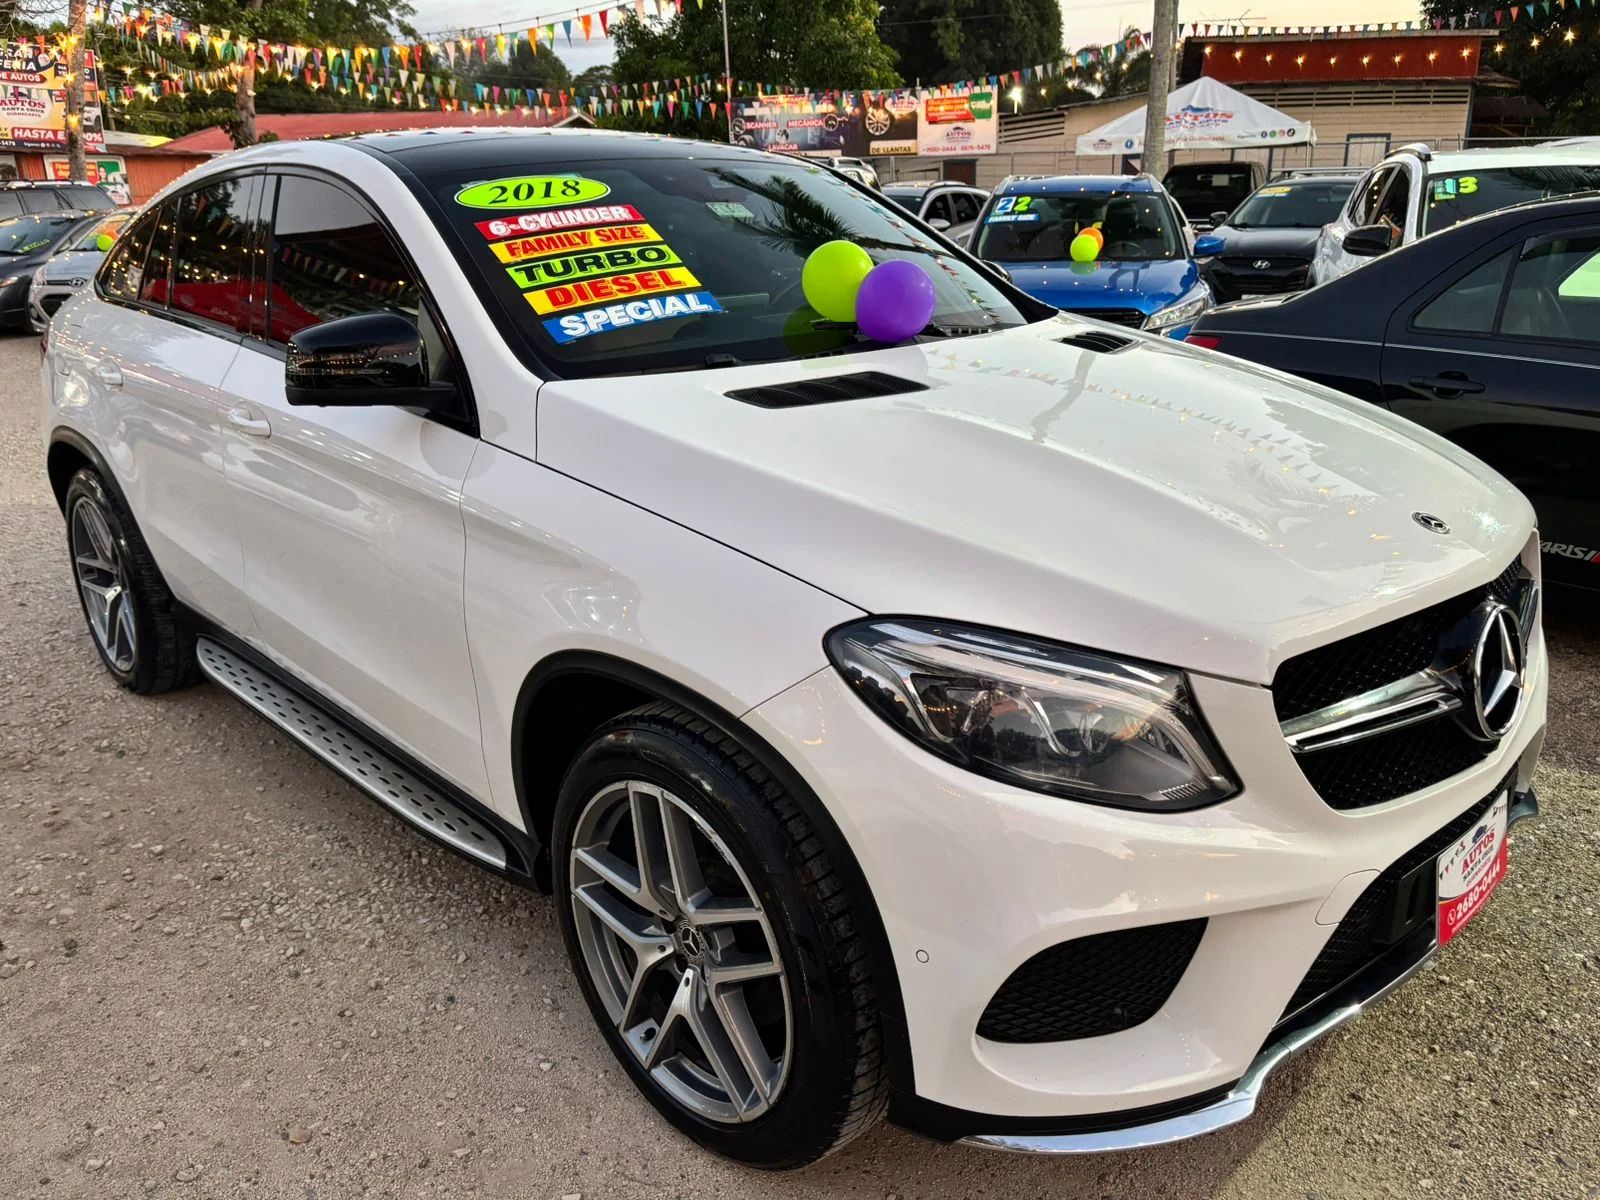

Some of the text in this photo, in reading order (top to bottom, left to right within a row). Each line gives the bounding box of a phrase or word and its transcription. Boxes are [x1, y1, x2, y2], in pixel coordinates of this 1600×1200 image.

[11, 73, 40, 82] AUTOS
[0, 98, 46, 109] AUTOS
[14, 128, 54, 140] HASTA
[57, 130, 66, 140] E
[746, 121, 777, 130] SCANNER
[488, 179, 582, 205] 2018
[997, 196, 1031, 211] 22
[489, 204, 631, 237] 6-CYLINDER
[507, 225, 647, 257] FAMILY SIZE
[514, 246, 673, 283] TURBO
[545, 270, 685, 309] DIESEL
[559, 293, 713, 337] SPECIAL
[1461, 828, 1495, 875] AUTOS
[1462, 859, 1481, 882] SANTA
[1457, 858, 1500, 920] 2680-0444
